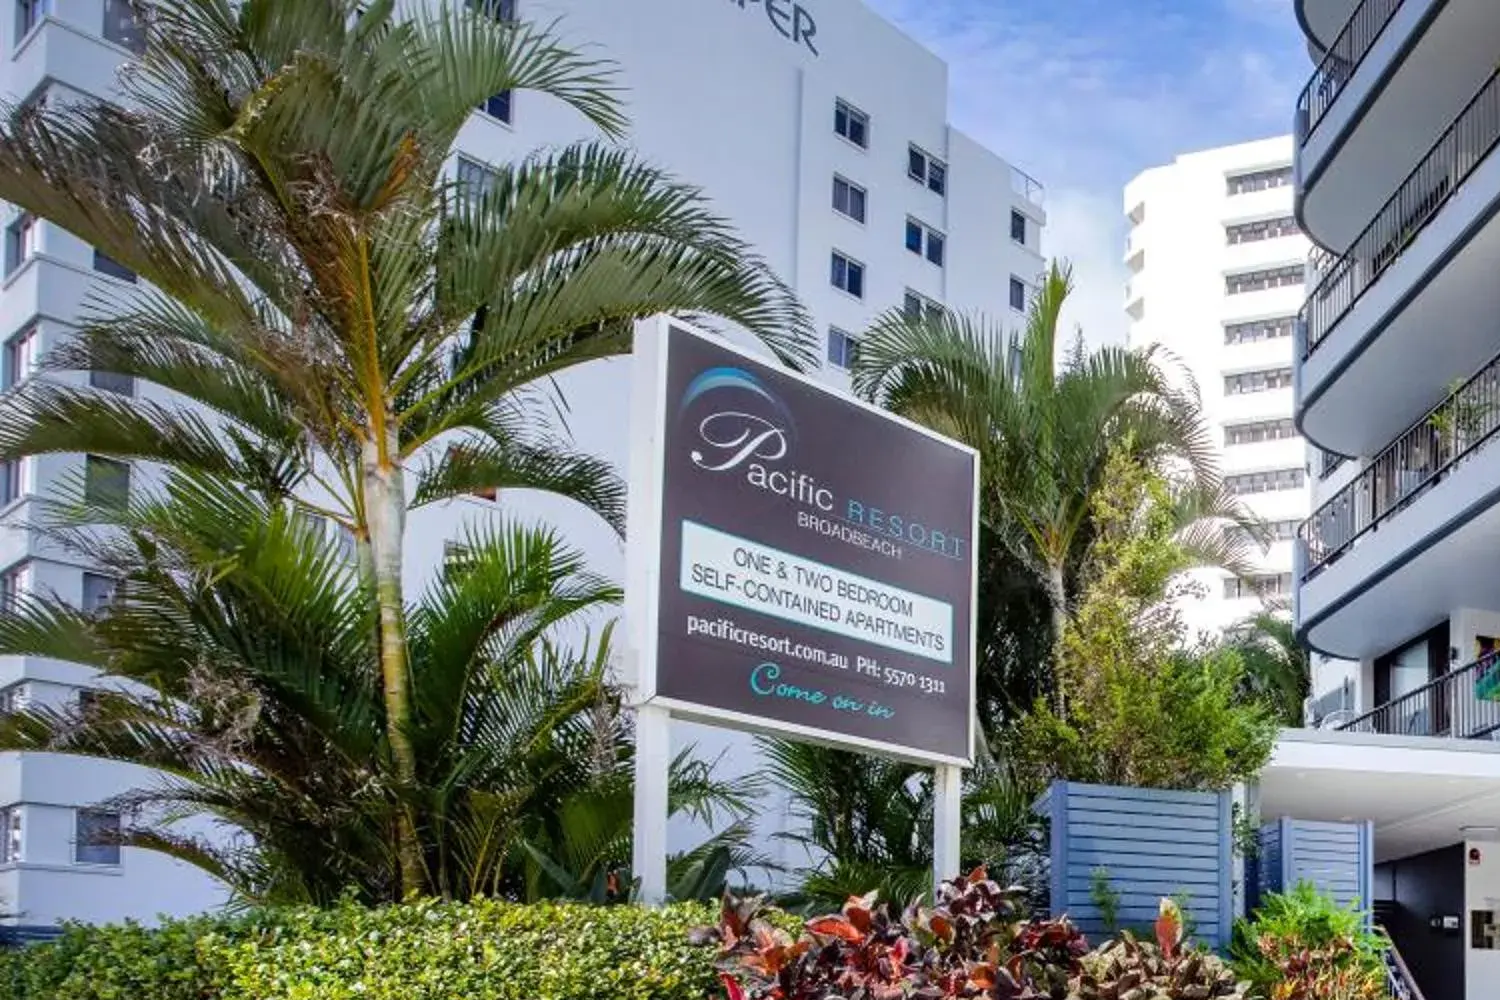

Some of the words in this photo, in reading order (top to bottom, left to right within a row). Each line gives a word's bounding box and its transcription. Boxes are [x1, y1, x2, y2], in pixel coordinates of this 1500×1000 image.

[738, 0, 819, 57] ER
[691, 411, 833, 511] Pacific
[846, 500, 965, 557] RESORT
[797, 511, 902, 557] BROADBEACH
[691, 563, 841, 622] SELF-CONTAINED
[846, 609, 945, 652] APARTMENTS
[733, 547, 771, 576] ONE
[776, 562, 789, 580] &
[794, 566, 834, 593] TWO
[837, 579, 913, 617] BEDROOM
[687, 615, 848, 669] pacificresort.com.au
[857, 655, 881, 678] PH:
[884, 666, 916, 688] 5570
[919, 676, 945, 694] 1311
[751, 662, 828, 704] Come
[832, 694, 864, 711] on
[867, 701, 895, 719] in
